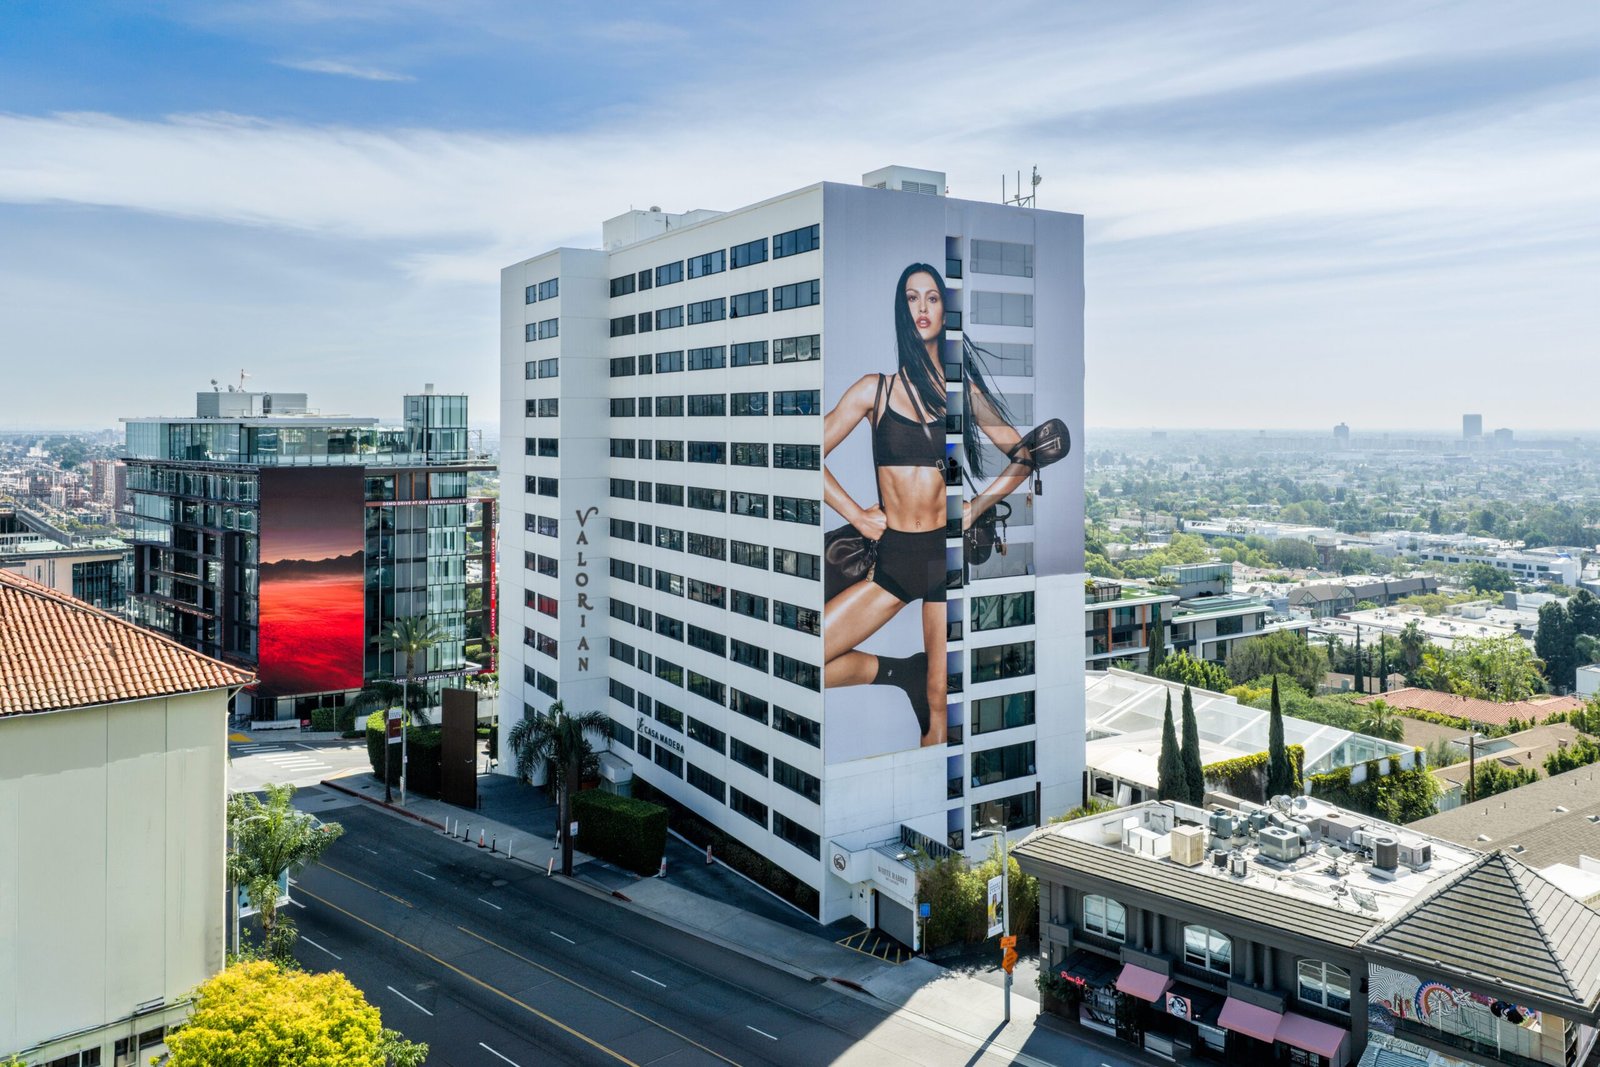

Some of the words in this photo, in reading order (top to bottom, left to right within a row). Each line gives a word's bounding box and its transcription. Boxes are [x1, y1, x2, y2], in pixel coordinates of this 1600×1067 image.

[575, 506, 599, 672] VALORIAN
[644, 726, 659, 740] CASA
[660, 733, 685, 754] MADERA
[892, 872, 908, 886] RABBIT
